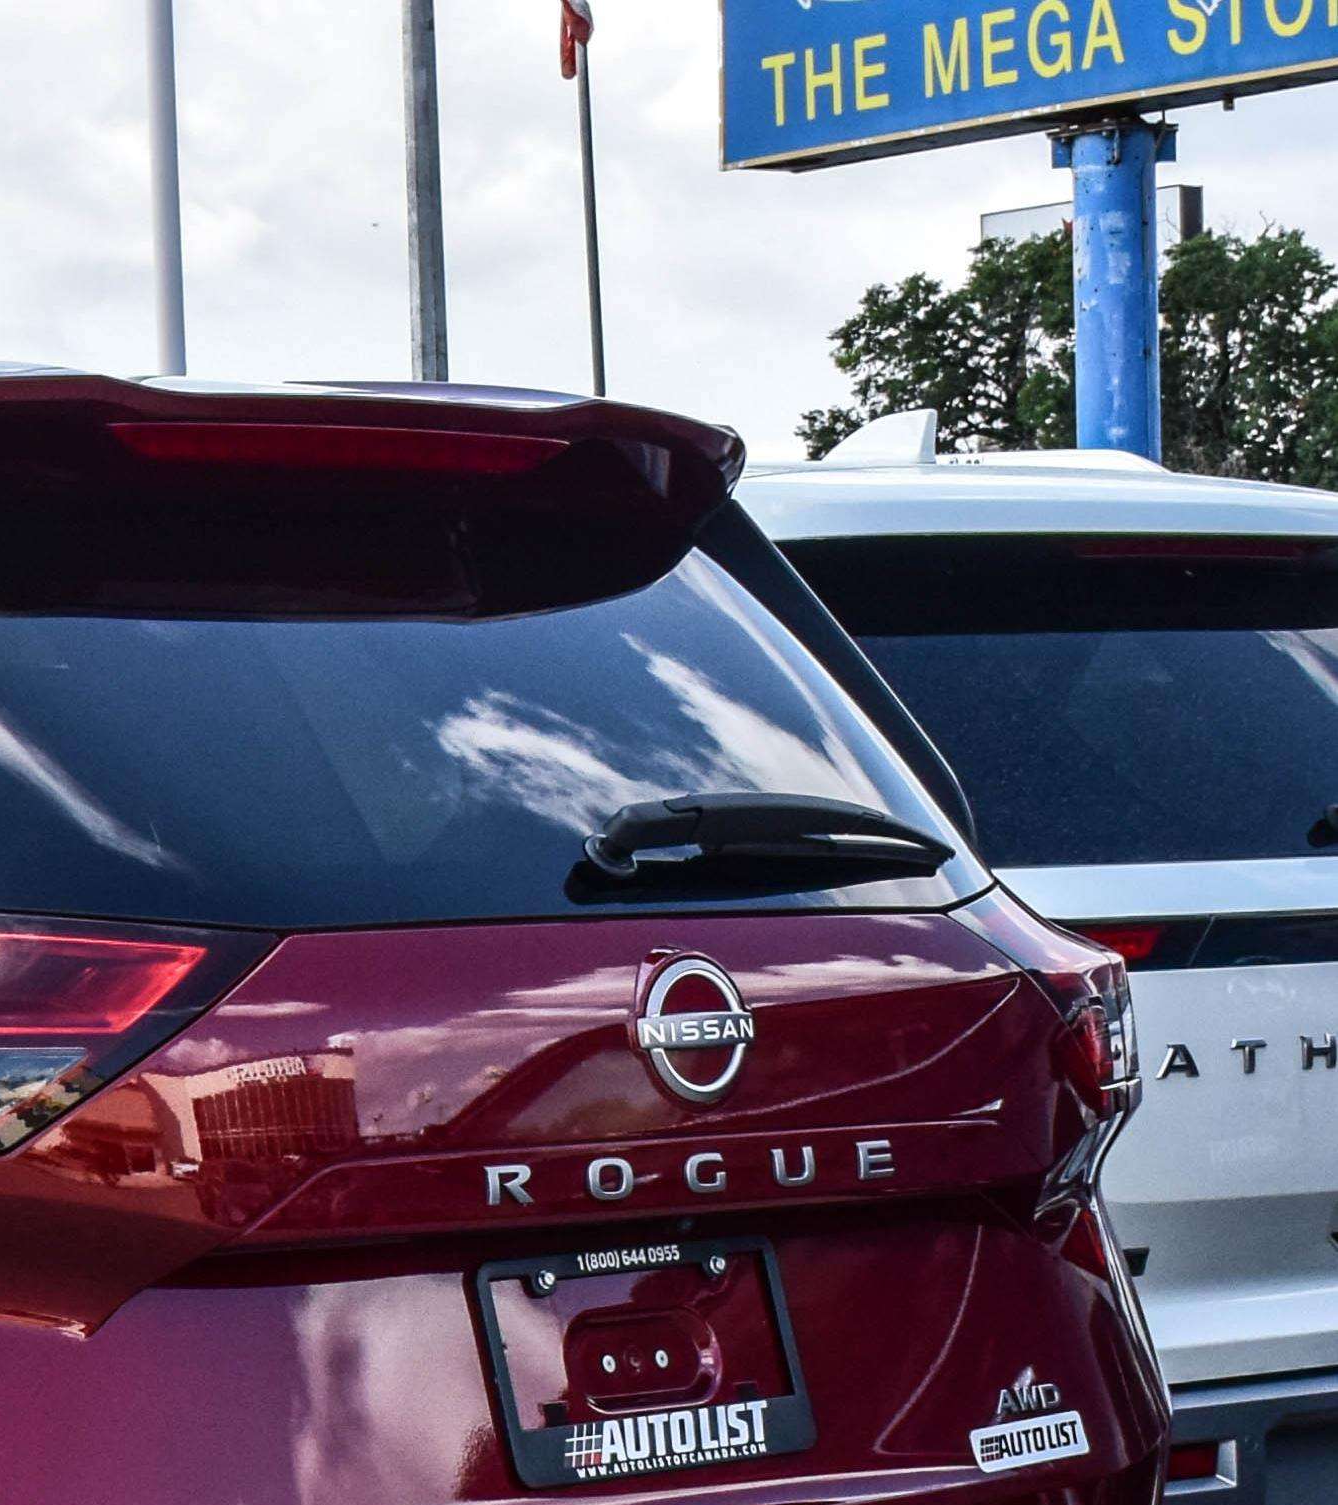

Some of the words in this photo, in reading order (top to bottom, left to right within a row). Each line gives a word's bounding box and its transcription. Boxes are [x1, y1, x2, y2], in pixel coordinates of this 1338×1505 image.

[762, 33, 890, 127] THE
[924, 0, 1125, 98] MEGA
[1167, 0, 1338, 56] ST
[642, 1016, 755, 1045] NISSAN
[1156, 1032, 1338, 1080] ATH
[484, 1139, 896, 1207] ROGUE
[997, 1383, 1061, 1416] AWD
